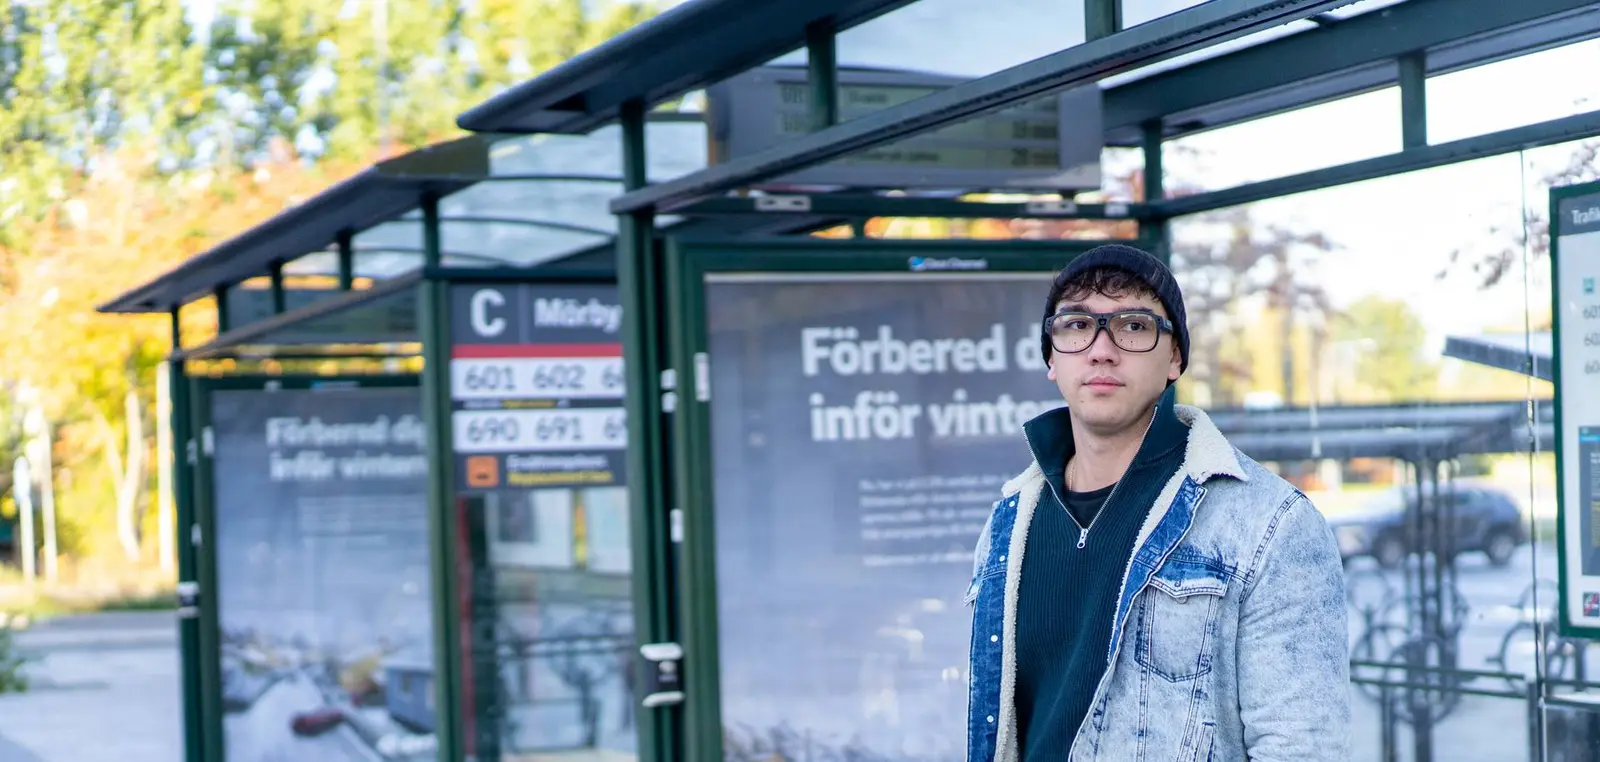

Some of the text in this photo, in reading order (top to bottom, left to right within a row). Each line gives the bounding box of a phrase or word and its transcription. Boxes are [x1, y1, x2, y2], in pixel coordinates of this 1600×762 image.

[470, 288, 507, 337] C
[534, 297, 623, 332] Mörby
[802, 324, 1007, 376] Förbered
[465, 365, 517, 390] 601
[533, 364, 585, 390] 602
[266, 415, 390, 447] Förbered
[466, 416, 519, 443] 690
[535, 416, 583, 442] 691
[809, 391, 922, 441] inför
